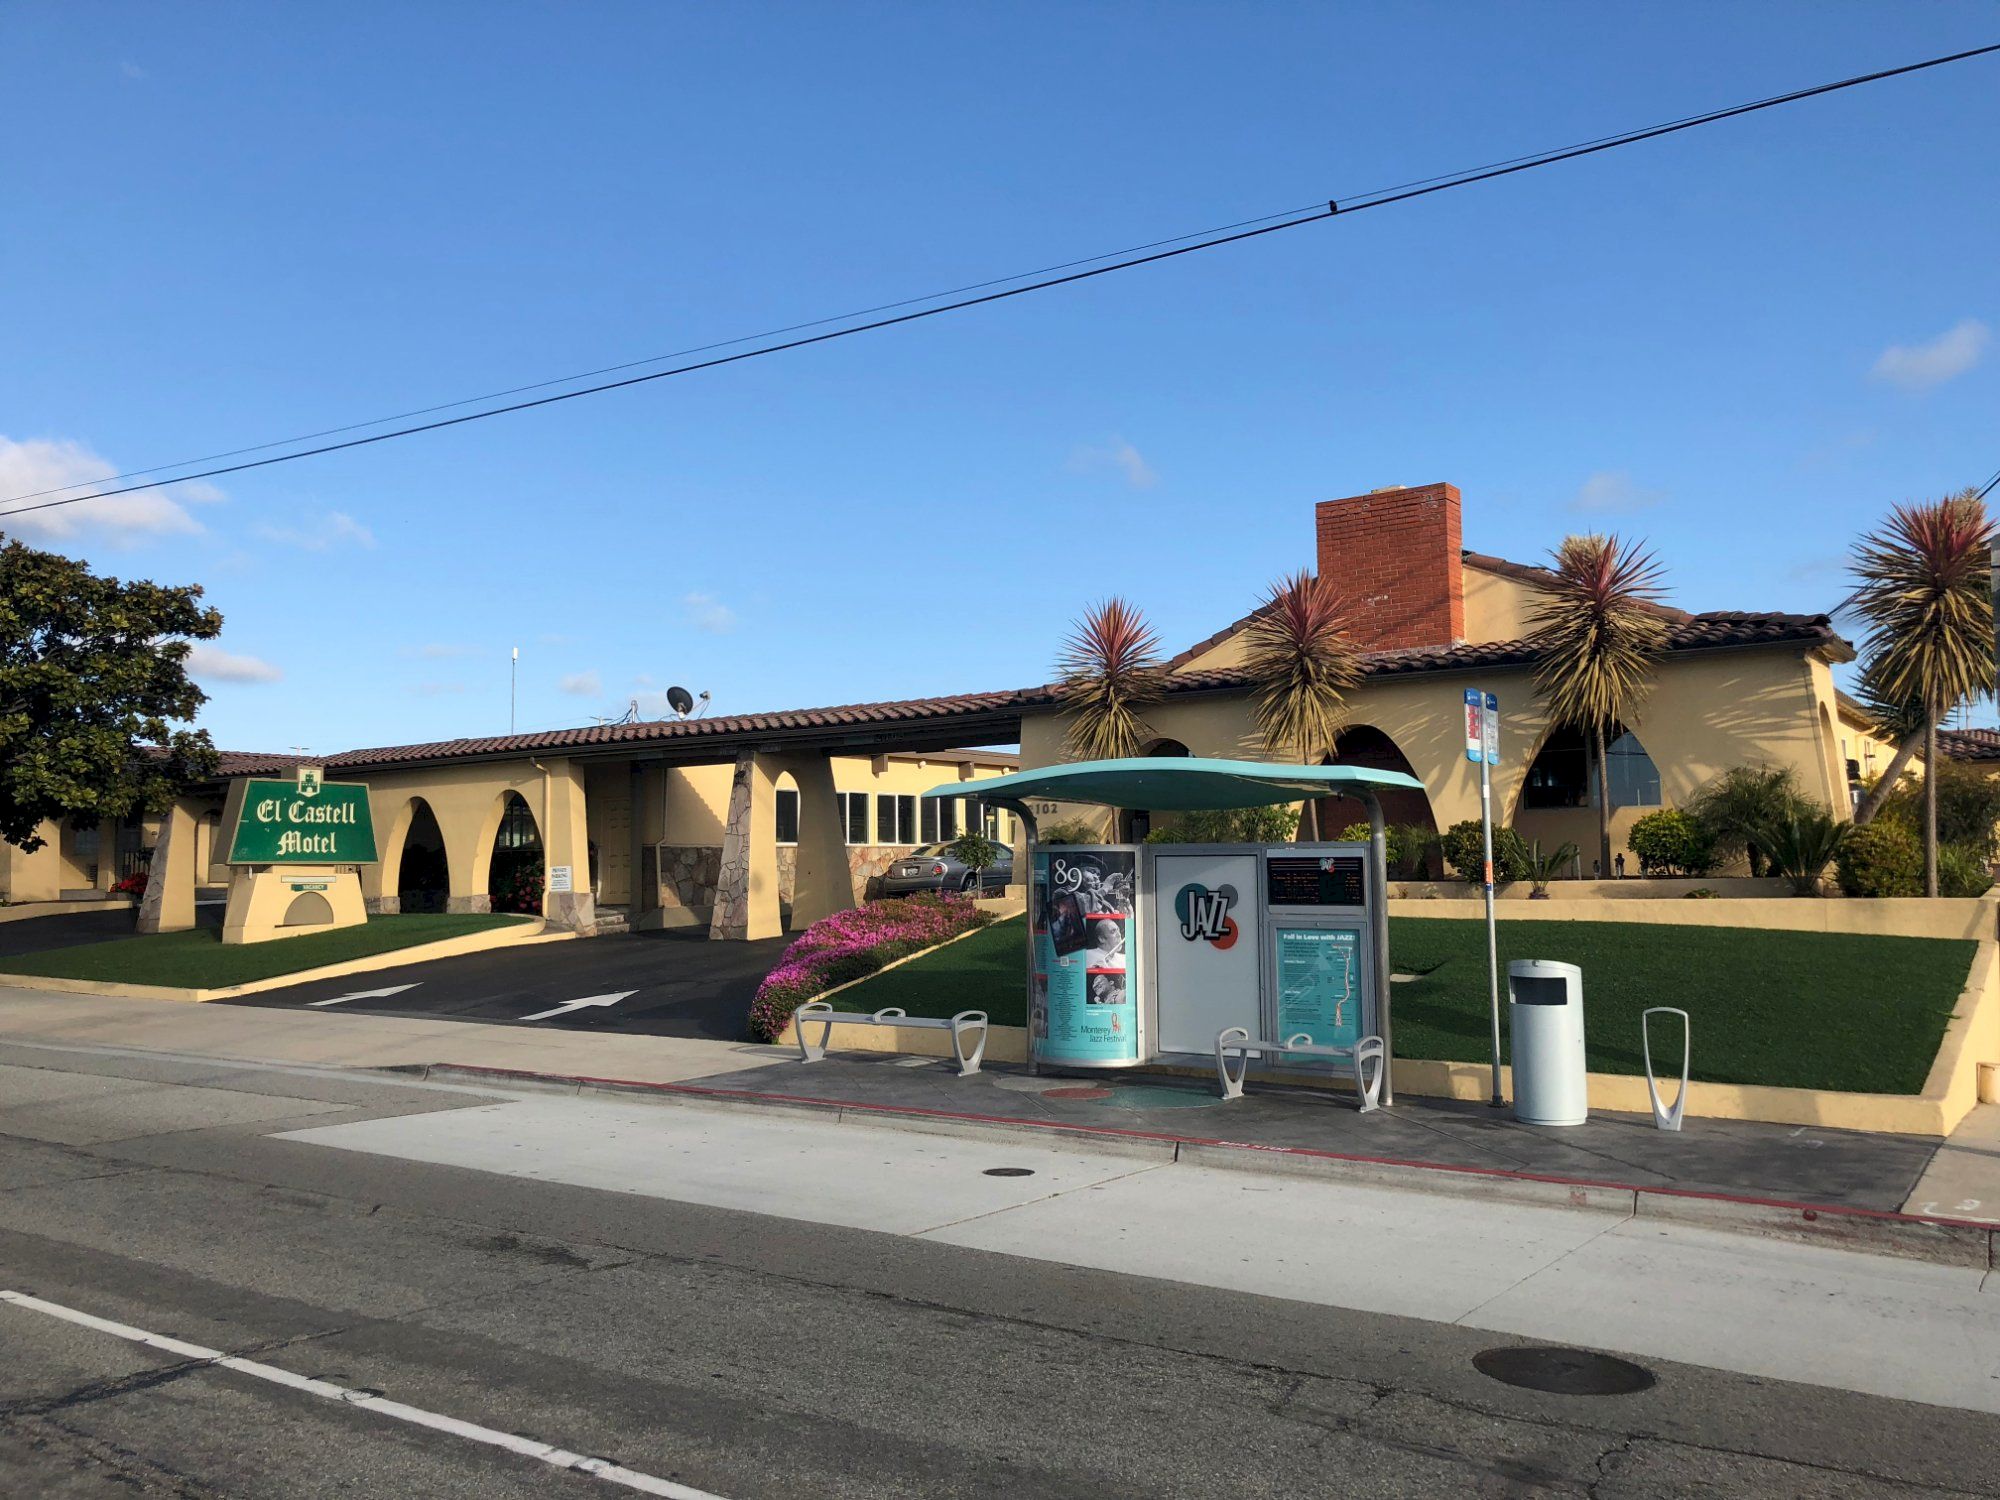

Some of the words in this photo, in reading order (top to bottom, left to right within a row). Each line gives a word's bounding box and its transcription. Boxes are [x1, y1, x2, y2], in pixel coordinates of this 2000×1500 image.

[257, 799, 282, 823] El
[288, 800, 356, 824] Castell
[276, 830, 337, 856] Motel
[1054, 858, 1082, 892] 89
[1181, 890, 1231, 941] JAZZ
[1081, 1025, 1111, 1035] Monterey
[1089, 1034, 1103, 1043] Jazz
[1103, 1034, 1126, 1042] Festival
